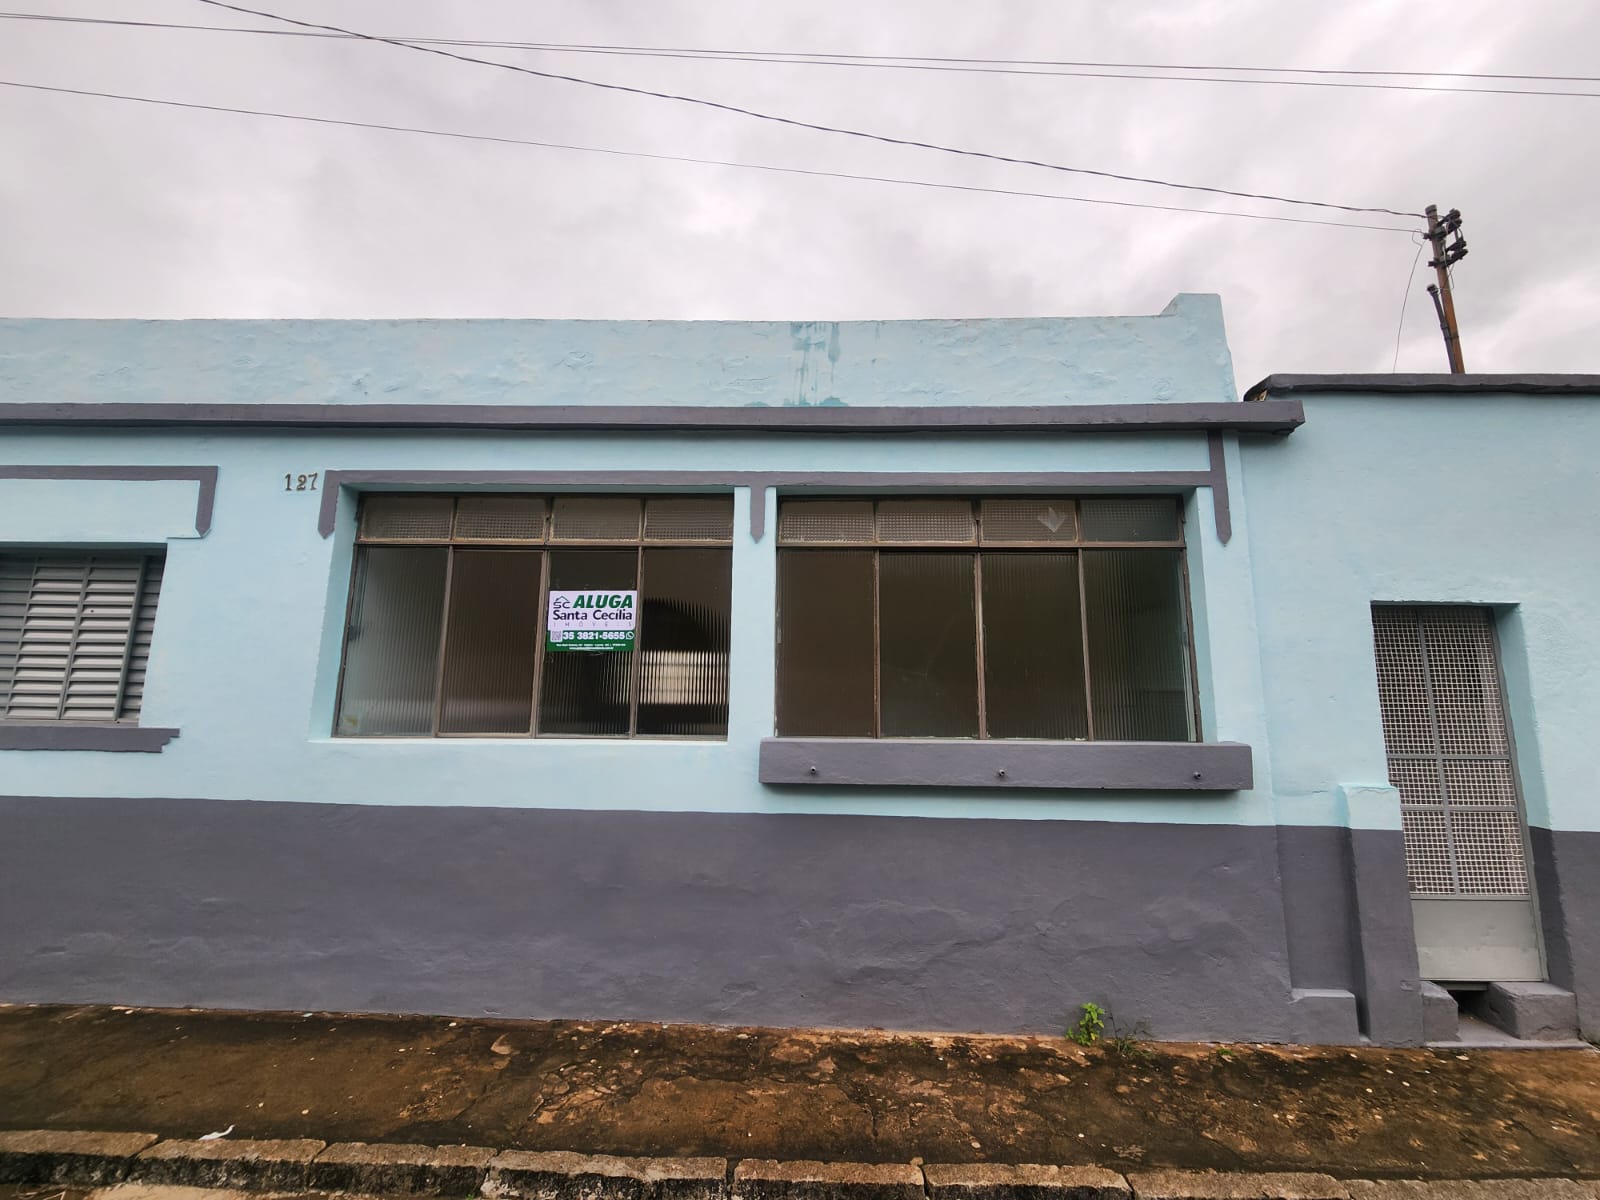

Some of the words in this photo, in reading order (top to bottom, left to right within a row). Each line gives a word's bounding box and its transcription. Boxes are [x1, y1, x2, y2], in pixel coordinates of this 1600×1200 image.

[284, 472, 318, 491] 127
[572, 594, 633, 609] ALUGA
[553, 609, 588, 621] Santa
[562, 631, 575, 640] 35
